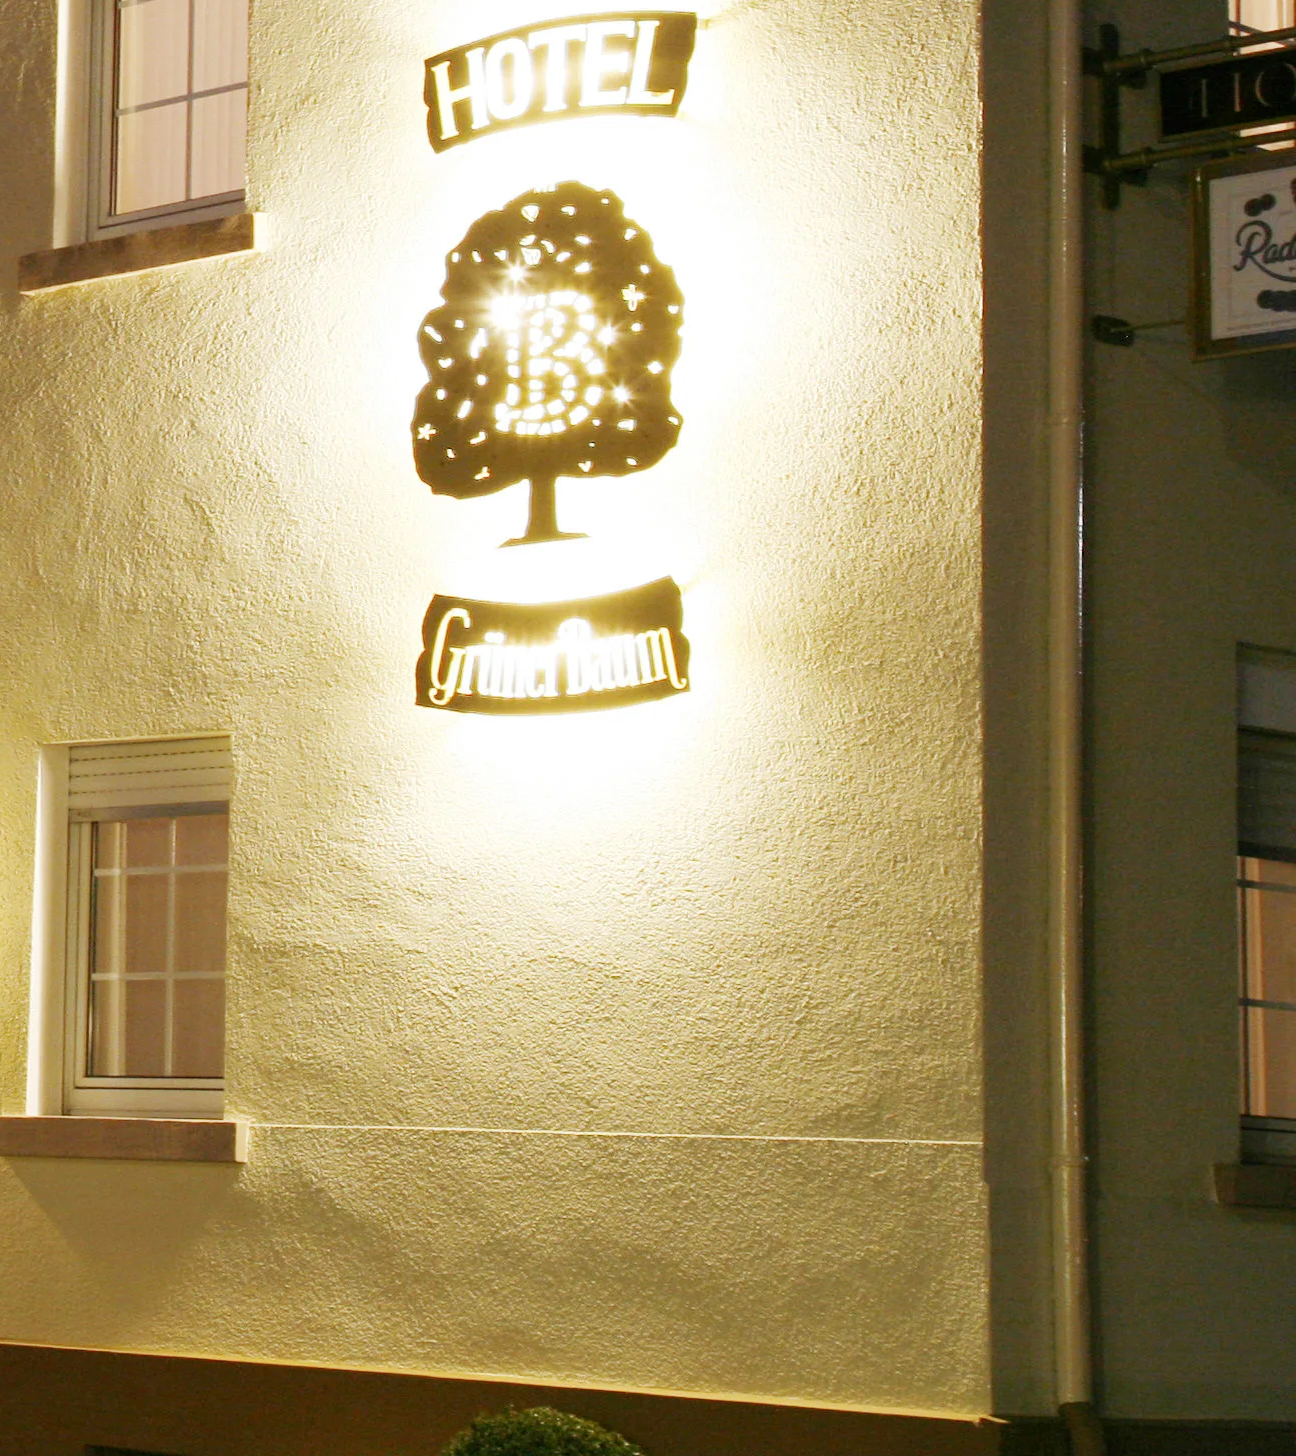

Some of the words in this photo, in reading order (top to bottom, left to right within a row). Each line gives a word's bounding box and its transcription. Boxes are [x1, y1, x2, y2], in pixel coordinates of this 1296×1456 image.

[431, 20, 674, 140] HOTEL
[428, 608, 557, 705] Grüner
[557, 618, 687, 696] Baum
